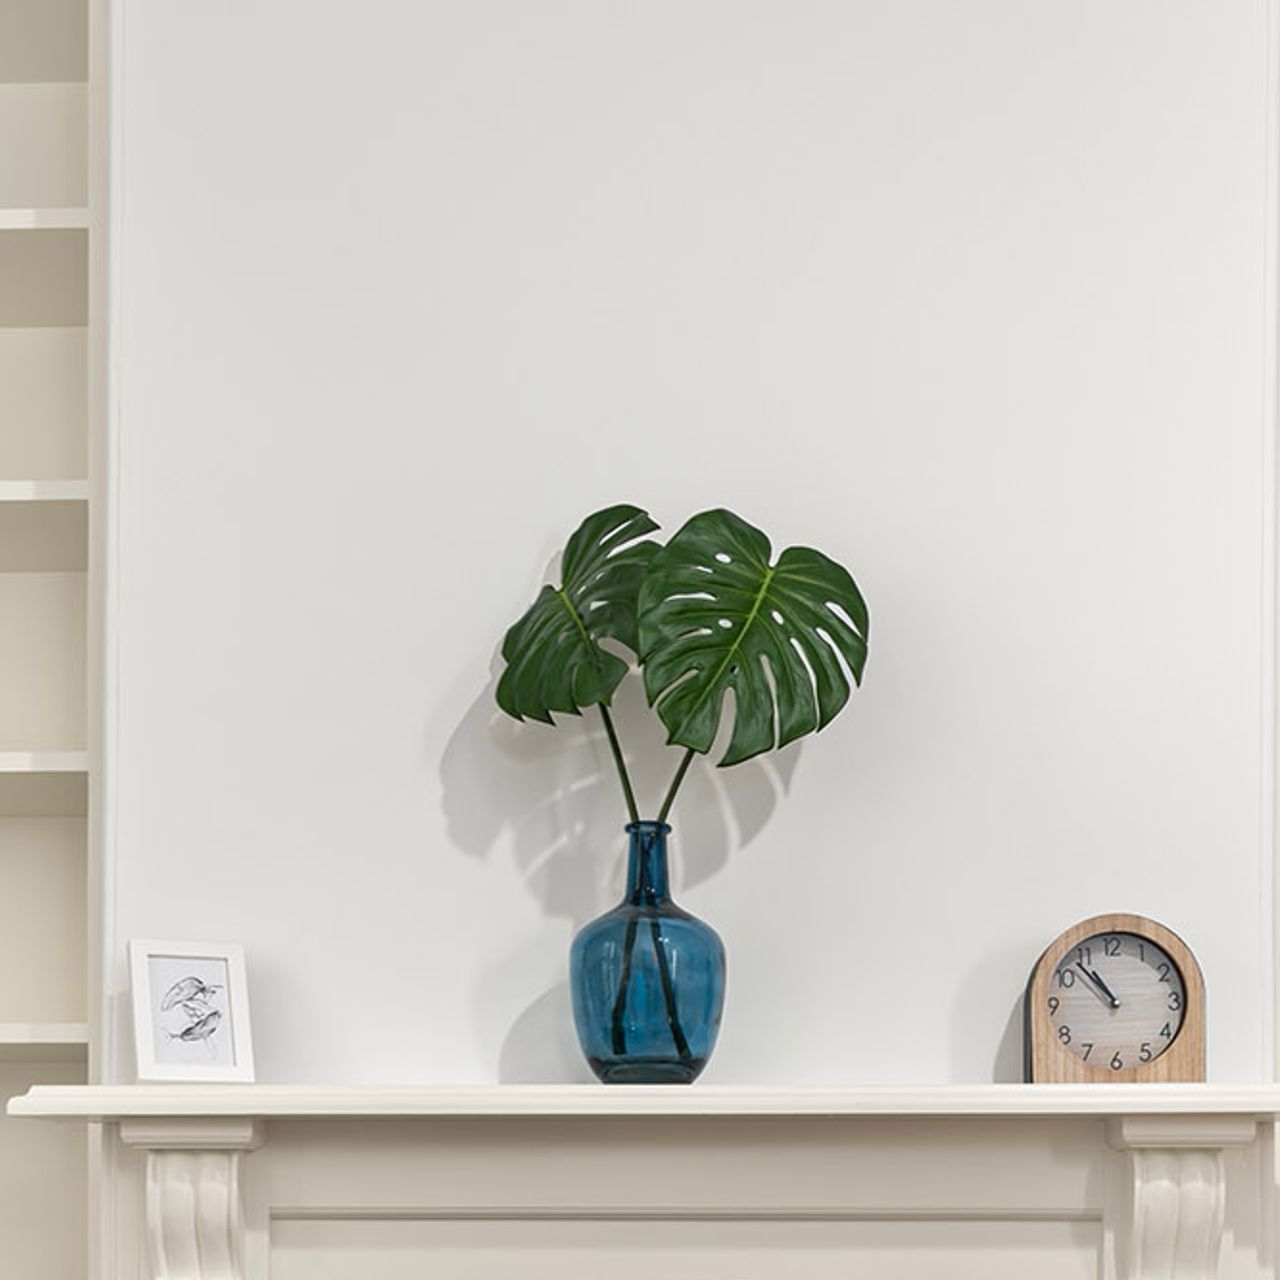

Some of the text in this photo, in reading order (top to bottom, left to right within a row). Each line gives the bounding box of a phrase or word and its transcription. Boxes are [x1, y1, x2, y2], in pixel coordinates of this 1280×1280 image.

[1078, 947, 1091, 965] 11
[1103, 937, 1121, 957] 12
[1139, 943, 1145, 962] 1
[1056, 968, 1075, 988] 10
[1157, 963, 1171, 983] 2
[1047, 996, 1060, 1016] 9
[1168, 992, 1181, 1011] 3
[1058, 1025, 1072, 1045] 8
[1160, 1022, 1172, 1040] 4
[1081, 1043, 1093, 1062] 7
[1110, 1051, 1123, 1070] 6
[1139, 1042, 1152, 1062] 5
